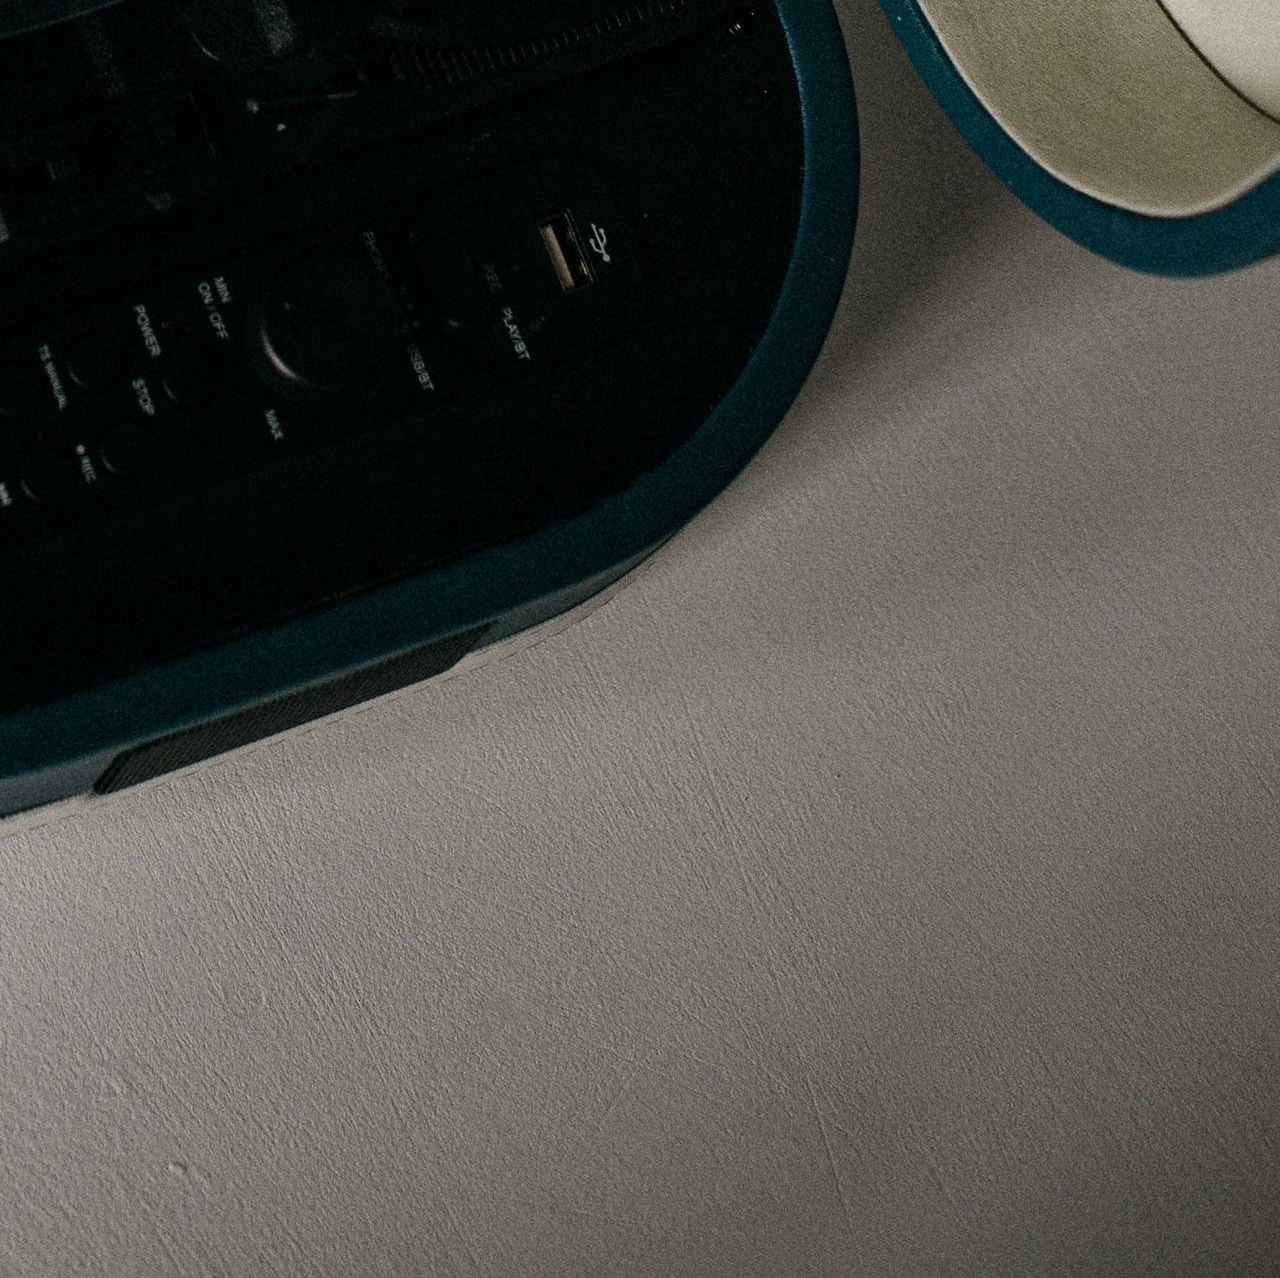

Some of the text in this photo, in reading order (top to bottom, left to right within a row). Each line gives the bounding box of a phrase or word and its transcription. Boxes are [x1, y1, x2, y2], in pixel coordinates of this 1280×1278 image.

[214, 276, 232, 304] MIN
[133, 304, 162, 358] POWER
[501, 306, 531, 360] PLAY/BT
[132, 377, 155, 416] STOP
[264, 408, 284, 442] MAX
